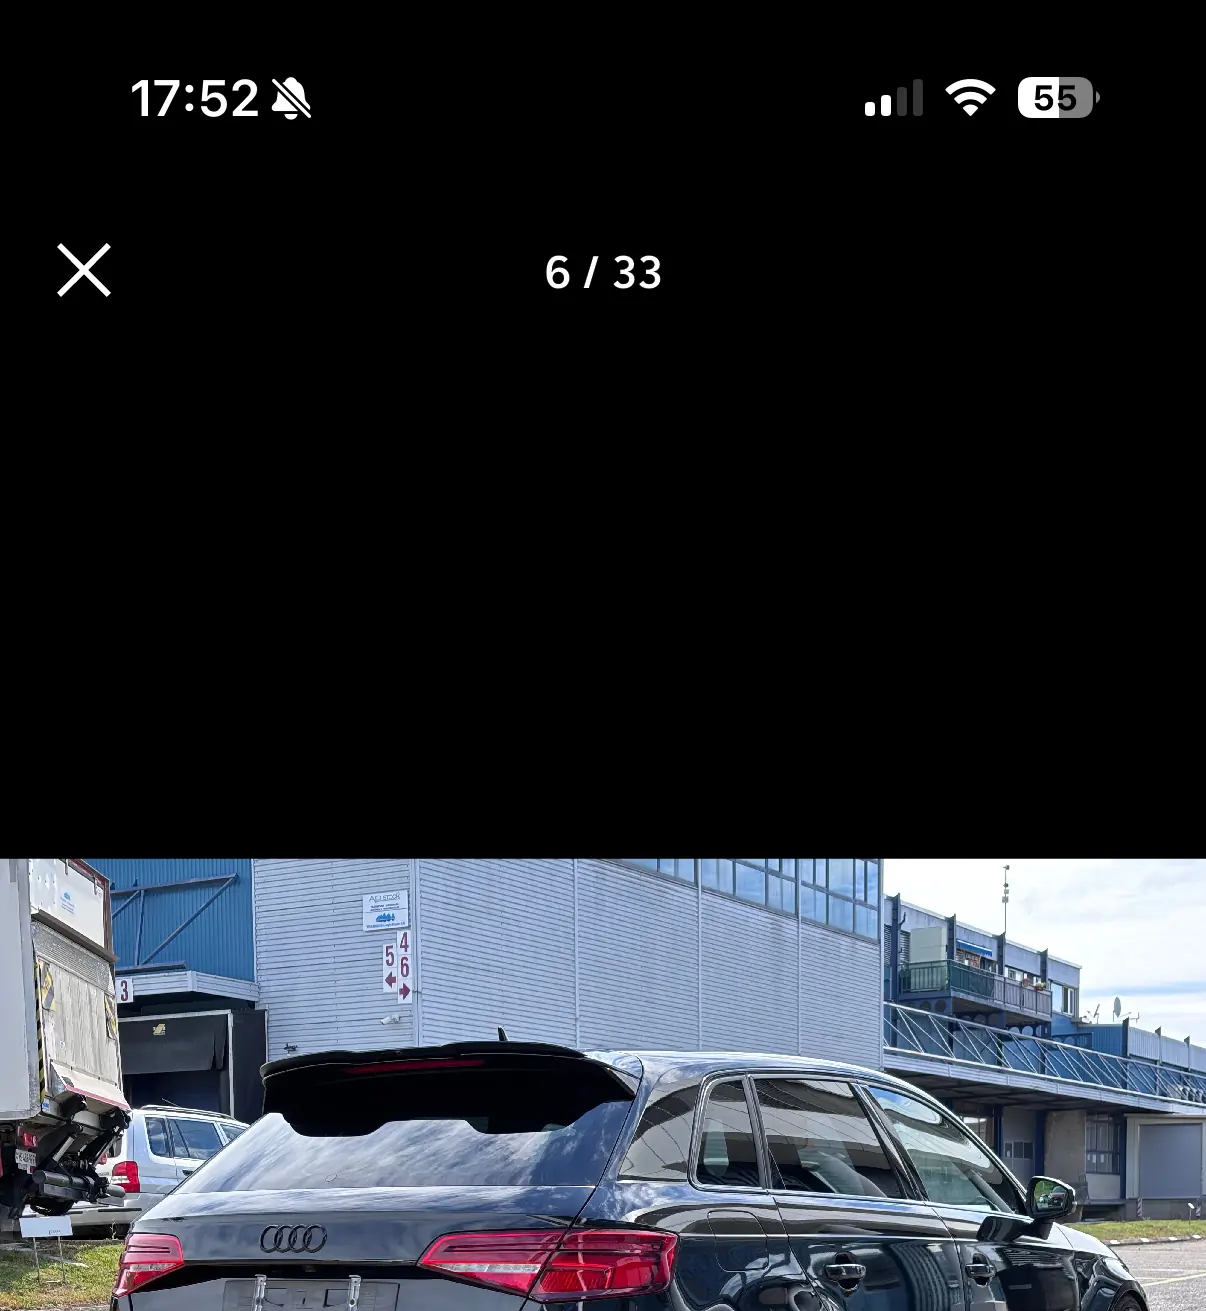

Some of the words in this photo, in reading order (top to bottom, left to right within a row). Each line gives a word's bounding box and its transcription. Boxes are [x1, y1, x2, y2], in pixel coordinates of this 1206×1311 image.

[400, 932, 409, 952] 4
[385, 945, 394, 966] 5
[400, 956, 409, 977] 6
[121, 980, 128, 1001] 3
